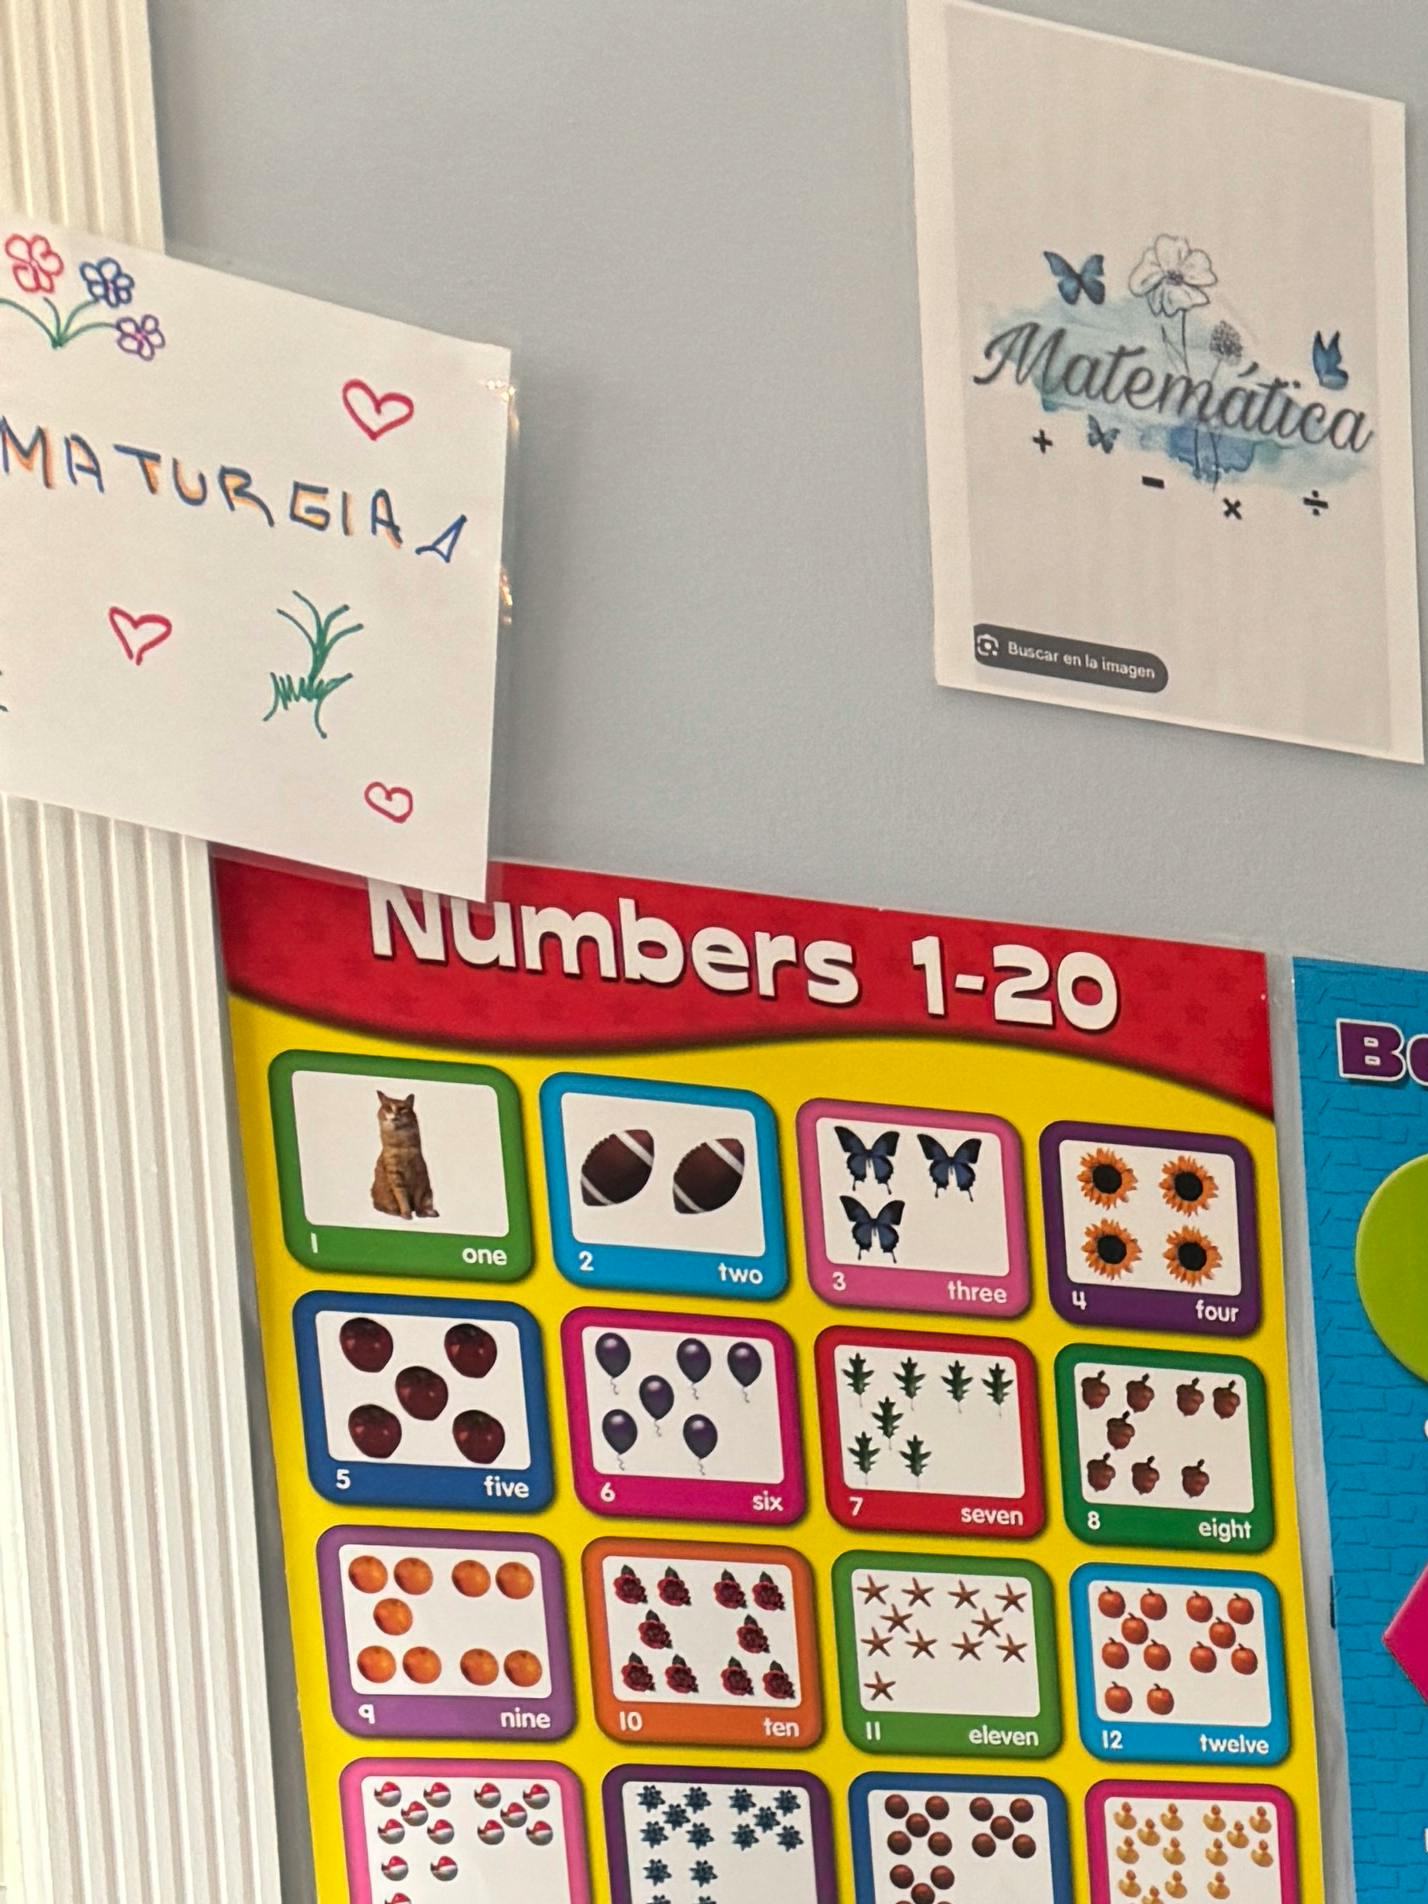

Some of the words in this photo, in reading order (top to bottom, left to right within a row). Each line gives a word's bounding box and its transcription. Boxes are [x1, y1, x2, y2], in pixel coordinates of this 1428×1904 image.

[973, 321, 1375, 454] Matemática
[1, 415, 404, 550] MATURGIA
[1007, 641, 1060, 664] Buscar
[1063, 654, 1082, 669] en
[1085, 653, 1099, 671] la
[1101, 657, 1156, 682] imagen
[367, 876, 861, 1004] Numbers
[911, 935, 1119, 1032] 1-20
[309, 1232, 319, 1253] 1
[461, 1247, 508, 1266] one
[579, 1252, 594, 1272] 2
[717, 1264, 763, 1285] two
[832, 1272, 847, 1292] 3
[947, 1281, 1008, 1305] three
[1071, 1291, 1087, 1311] 4
[1195, 1301, 1240, 1324] four
[335, 1469, 351, 1490] 5
[484, 1476, 530, 1499] five
[600, 1482, 616, 1502] 6
[752, 1492, 785, 1513] six
[848, 1496, 863, 1516] 7
[960, 1507, 1024, 1527] seven
[1086, 1511, 1101, 1531] 8
[1198, 1519, 1252, 1544] eight
[358, 1704, 376, 1726] 9
[500, 1707, 552, 1731] nine
[618, 1711, 643, 1732] 10
[763, 1717, 801, 1738] ten
[865, 1721, 882, 1741] 11
[968, 1724, 1040, 1747] eleven
[1101, 1730, 1124, 1750] 12
[1199, 1733, 1270, 1756] twelve
